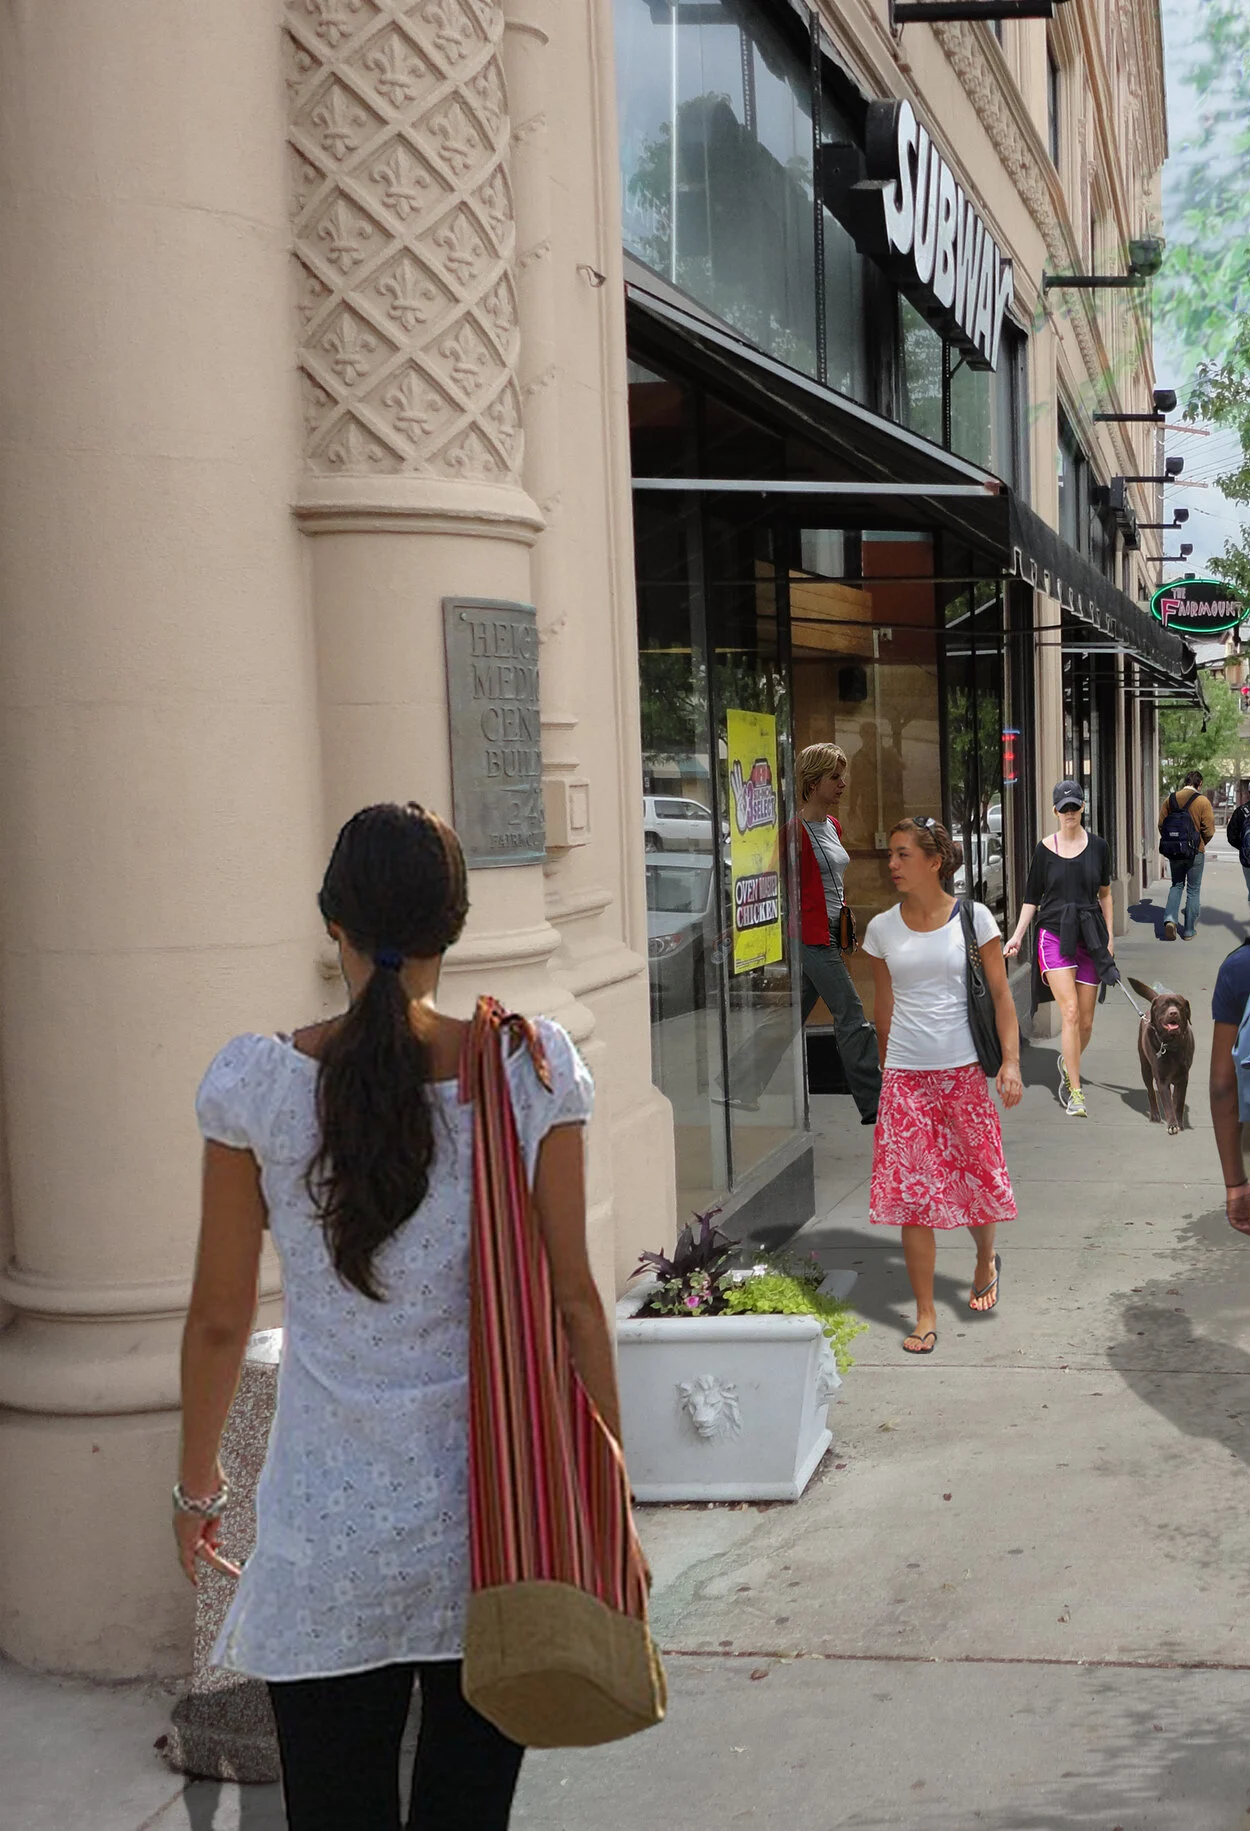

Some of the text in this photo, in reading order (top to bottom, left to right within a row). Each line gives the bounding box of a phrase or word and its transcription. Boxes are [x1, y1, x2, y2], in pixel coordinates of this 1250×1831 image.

[883, 98, 1014, 373] SUBWAY
[1171, 587, 1186, 600] THE
[753, 798, 775, 820] SELECT
[735, 878, 758, 905] OVEN
[737, 900, 778, 928] CHICKEN
